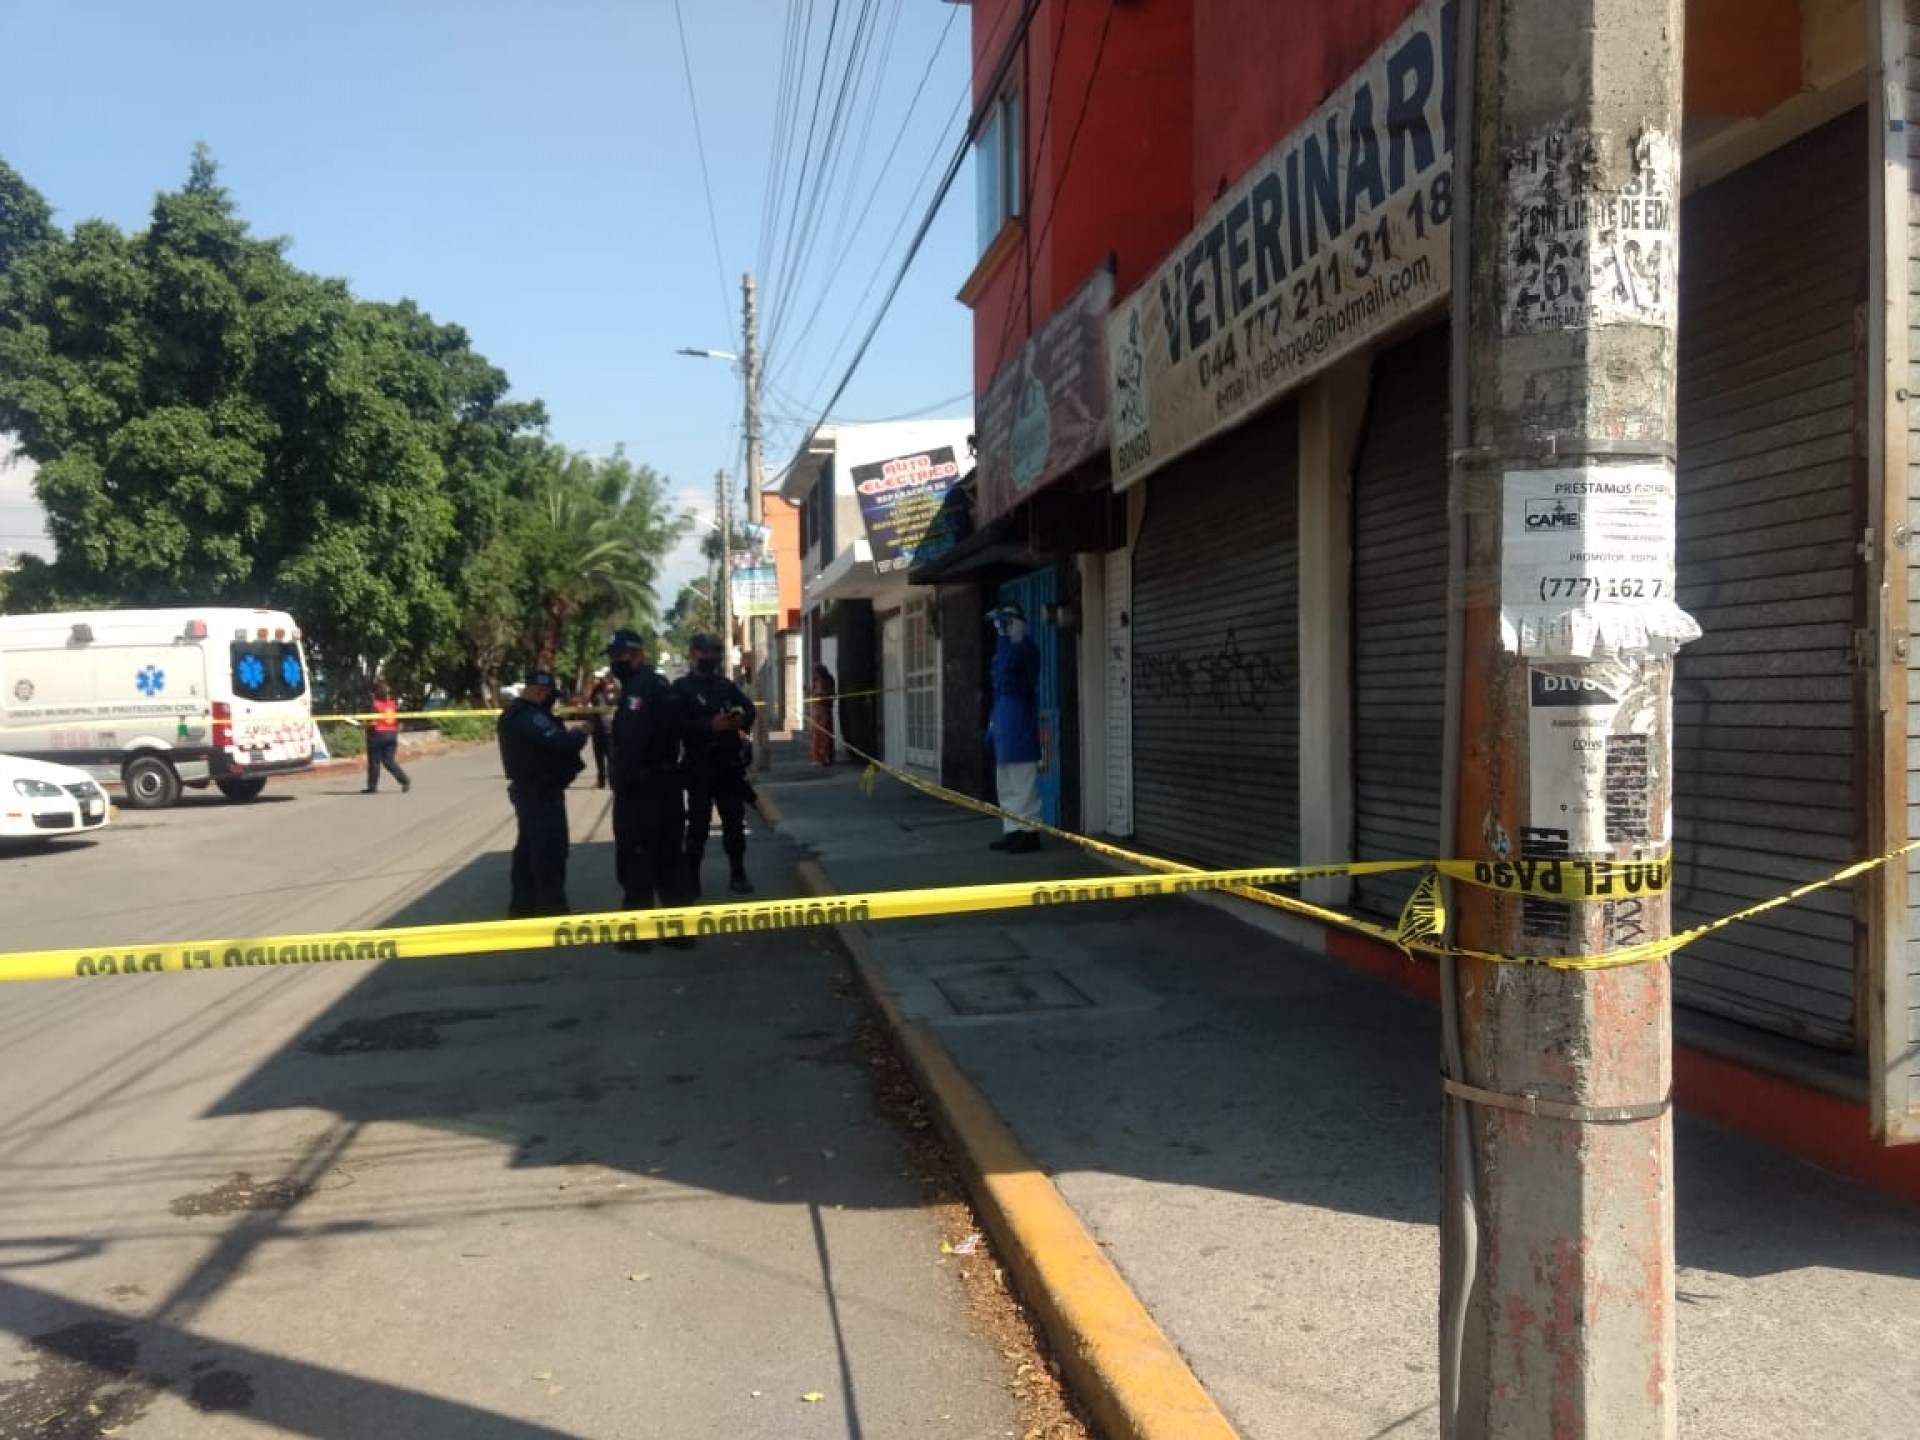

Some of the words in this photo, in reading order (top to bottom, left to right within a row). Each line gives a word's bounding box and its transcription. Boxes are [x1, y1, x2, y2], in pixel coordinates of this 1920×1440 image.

[1621, 200, 1640, 230] DE
[1199, 333, 1237, 388] 044
[1243, 293, 1284, 358] 777
[1292, 252, 1342, 323] 211
[1353, 225, 1392, 280] 31
[1406, 172, 1453, 239] 18
[884, 455, 930, 476] AUTO
[1554, 482, 1632, 494] PRESTAMOS
[1526, 513, 1579, 528] CAME
[1539, 576, 1600, 602] (777)
[1607, 577, 1645, 598] 162
[1652, 577, 1668, 598] 7
[1474, 860, 1564, 895] PASO
[1572, 861, 1613, 896] EL
